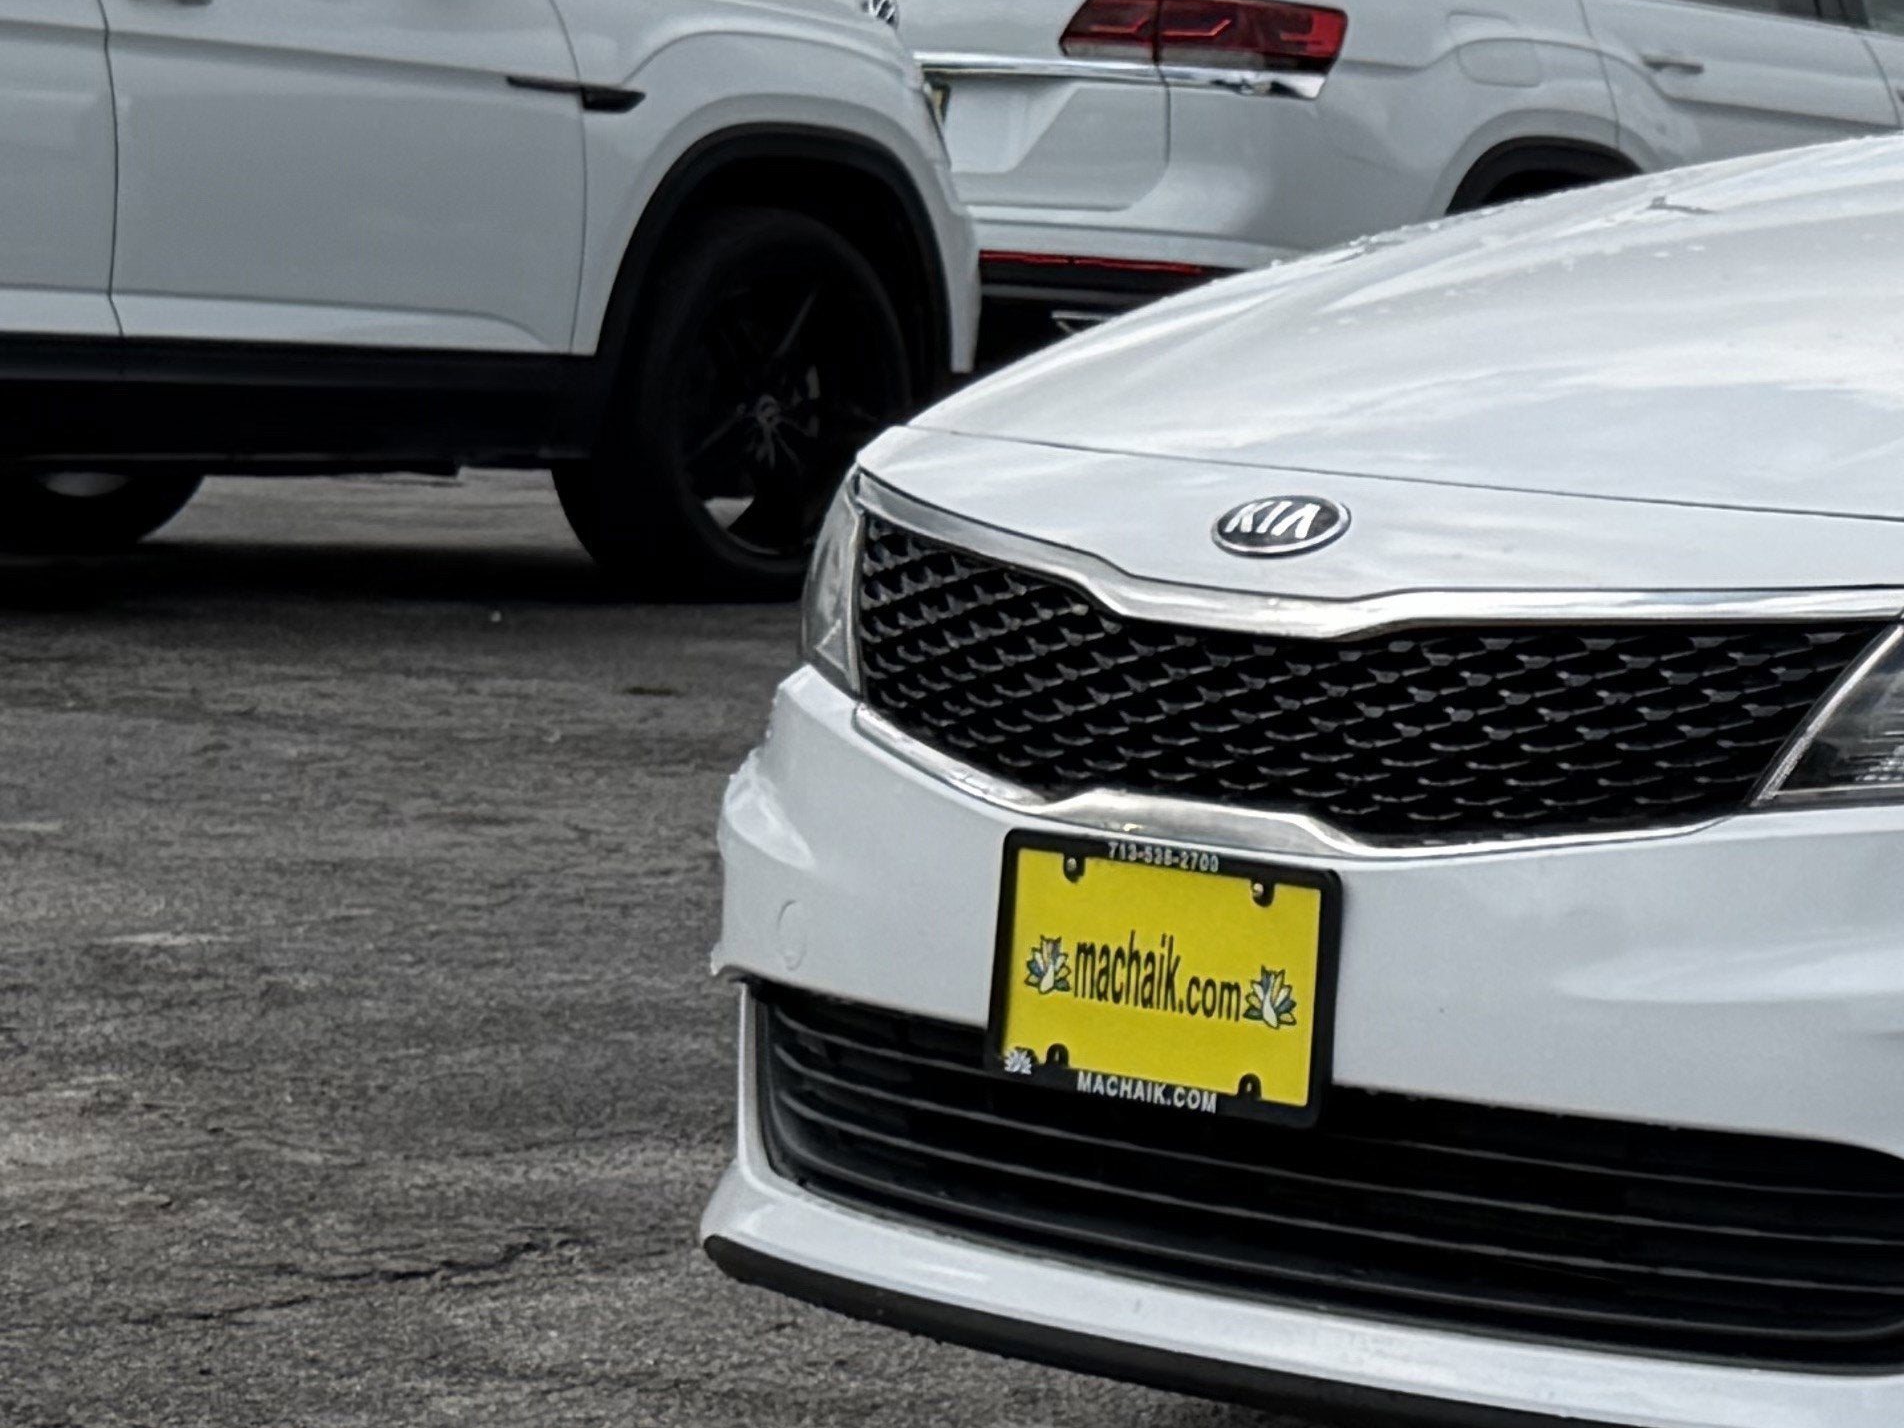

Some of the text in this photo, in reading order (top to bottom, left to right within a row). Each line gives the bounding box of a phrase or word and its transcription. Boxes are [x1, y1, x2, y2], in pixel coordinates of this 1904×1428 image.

[1224, 500, 1322, 540] KIA
[1074, 929, 1242, 1022] machaik.com
[1077, 1071, 1217, 1114] MACHAIK.COM
